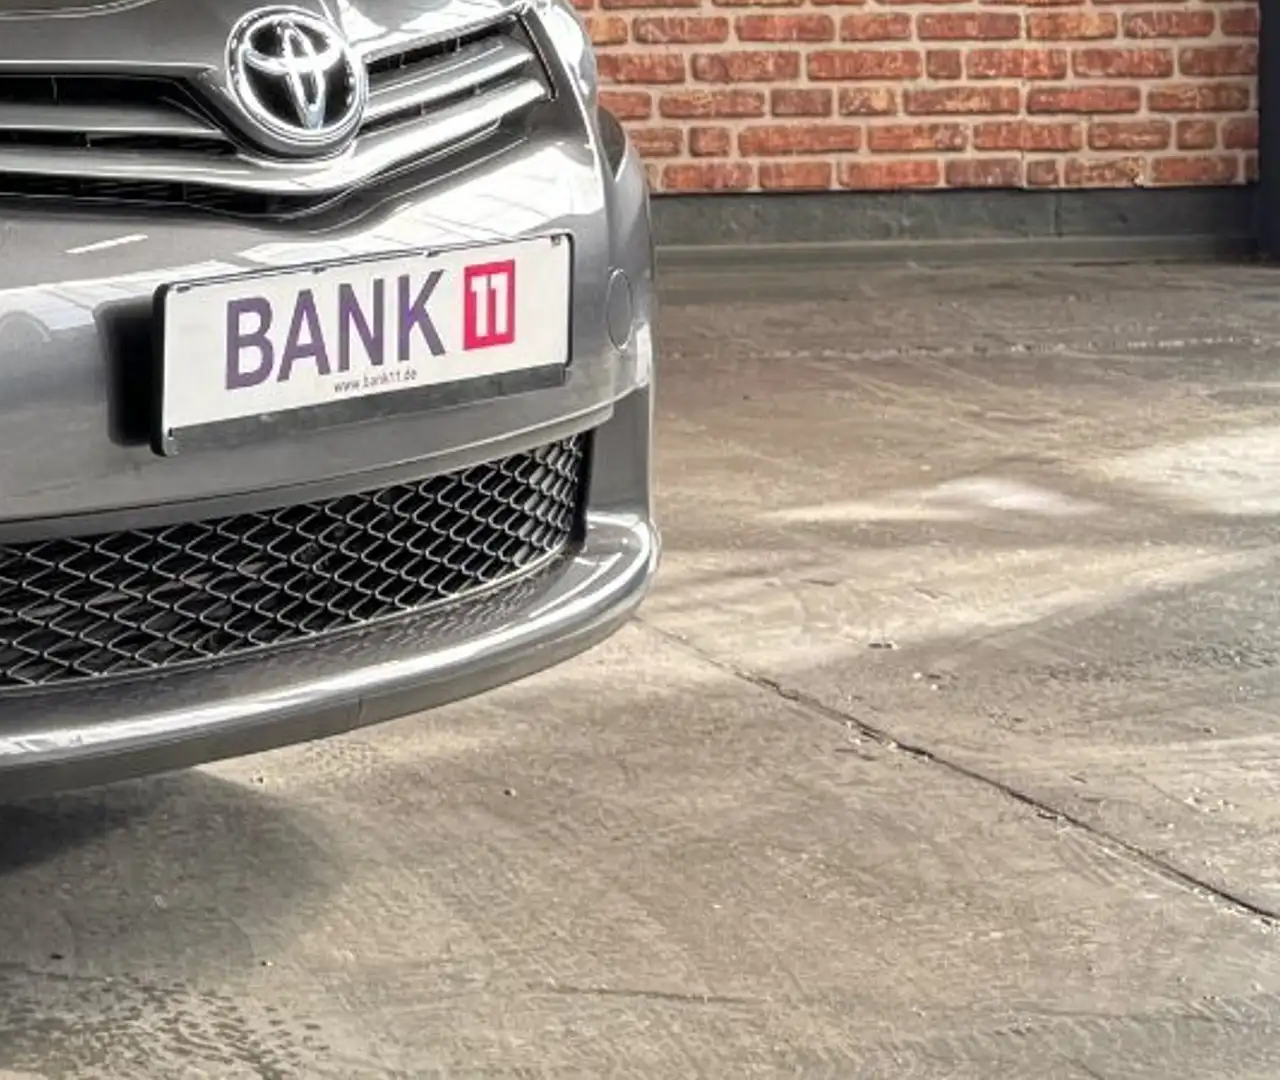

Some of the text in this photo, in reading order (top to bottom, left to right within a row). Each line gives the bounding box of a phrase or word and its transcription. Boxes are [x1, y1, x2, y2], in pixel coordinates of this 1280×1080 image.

[225, 269, 511, 391] BANK 11
[333, 369, 418, 393] www.bank11.de
